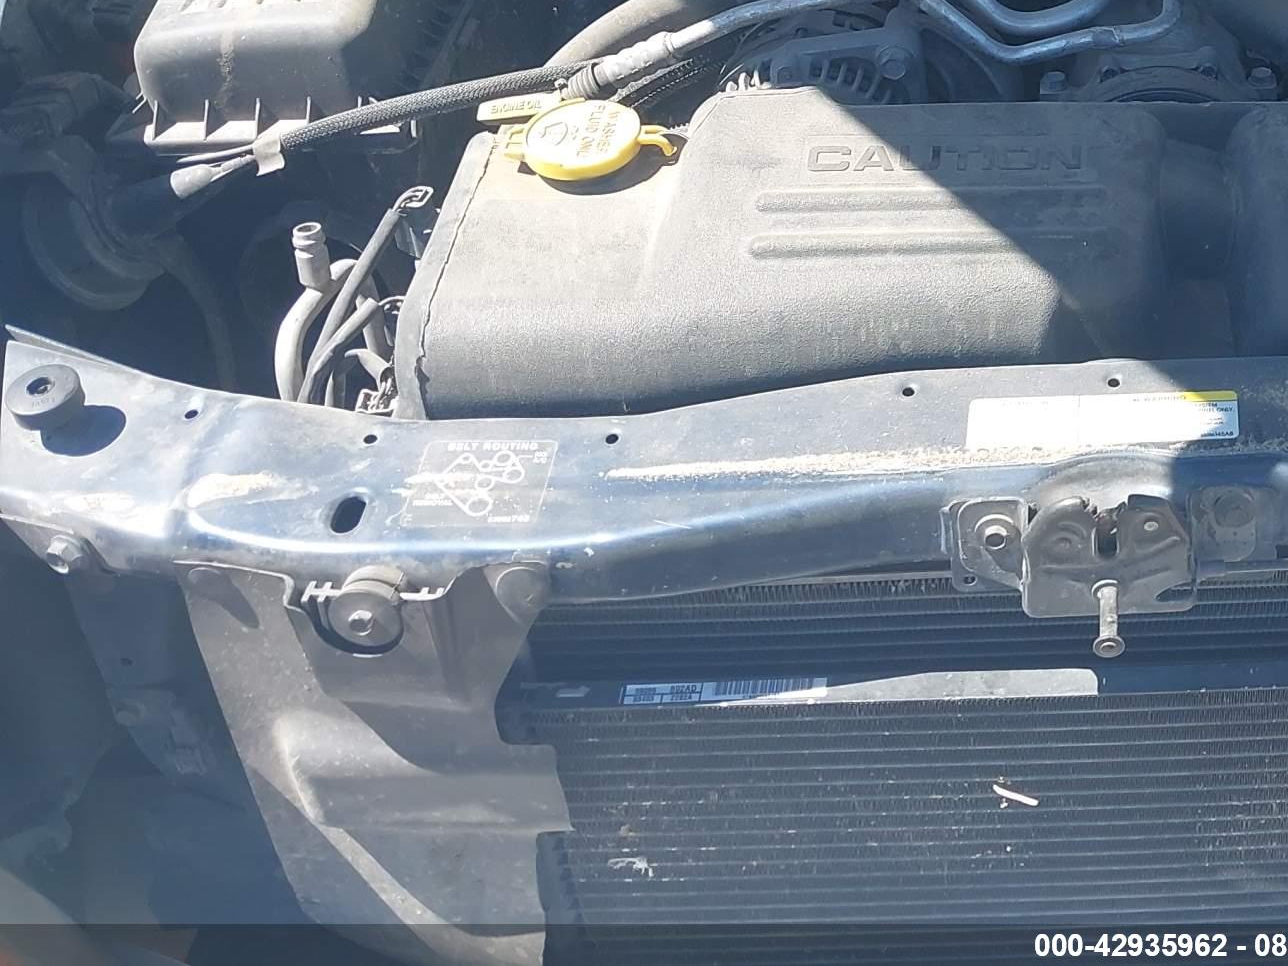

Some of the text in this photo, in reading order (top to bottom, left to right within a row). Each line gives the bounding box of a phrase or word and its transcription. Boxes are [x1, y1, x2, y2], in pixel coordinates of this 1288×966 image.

[489, 98, 543, 114] ENGINE OIL
[806, 144, 1084, 173] CAUTION
[448, 441, 539, 451] BELT ROUTING
